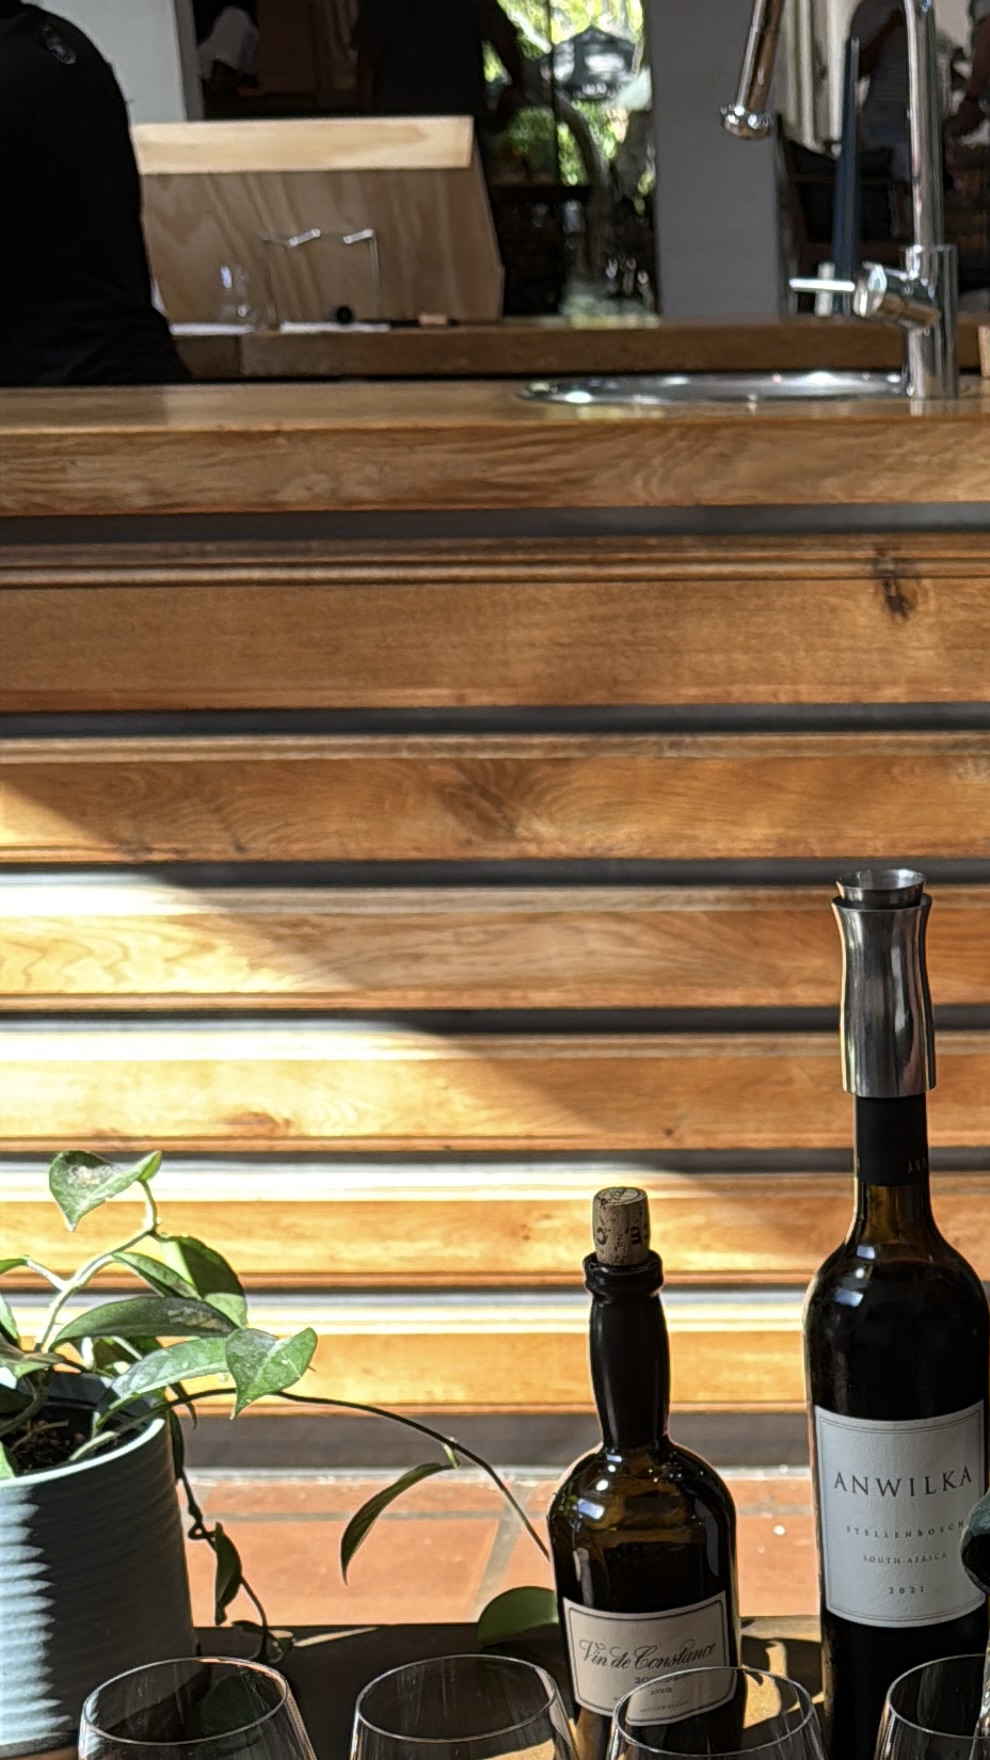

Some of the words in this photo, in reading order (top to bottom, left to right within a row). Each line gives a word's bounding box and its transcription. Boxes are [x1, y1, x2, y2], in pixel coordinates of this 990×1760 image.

[833, 1465, 973, 1498] ANWILKA
[846, 1520, 964, 1539] STELLENBOSCH
[863, 1555, 901, 1565] SOUTH
[906, 1552, 949, 1565] AFRICA
[889, 1586, 925, 1595] 2021
[579, 1639, 608, 1667] Vin
[609, 1646, 631, 1669] de
